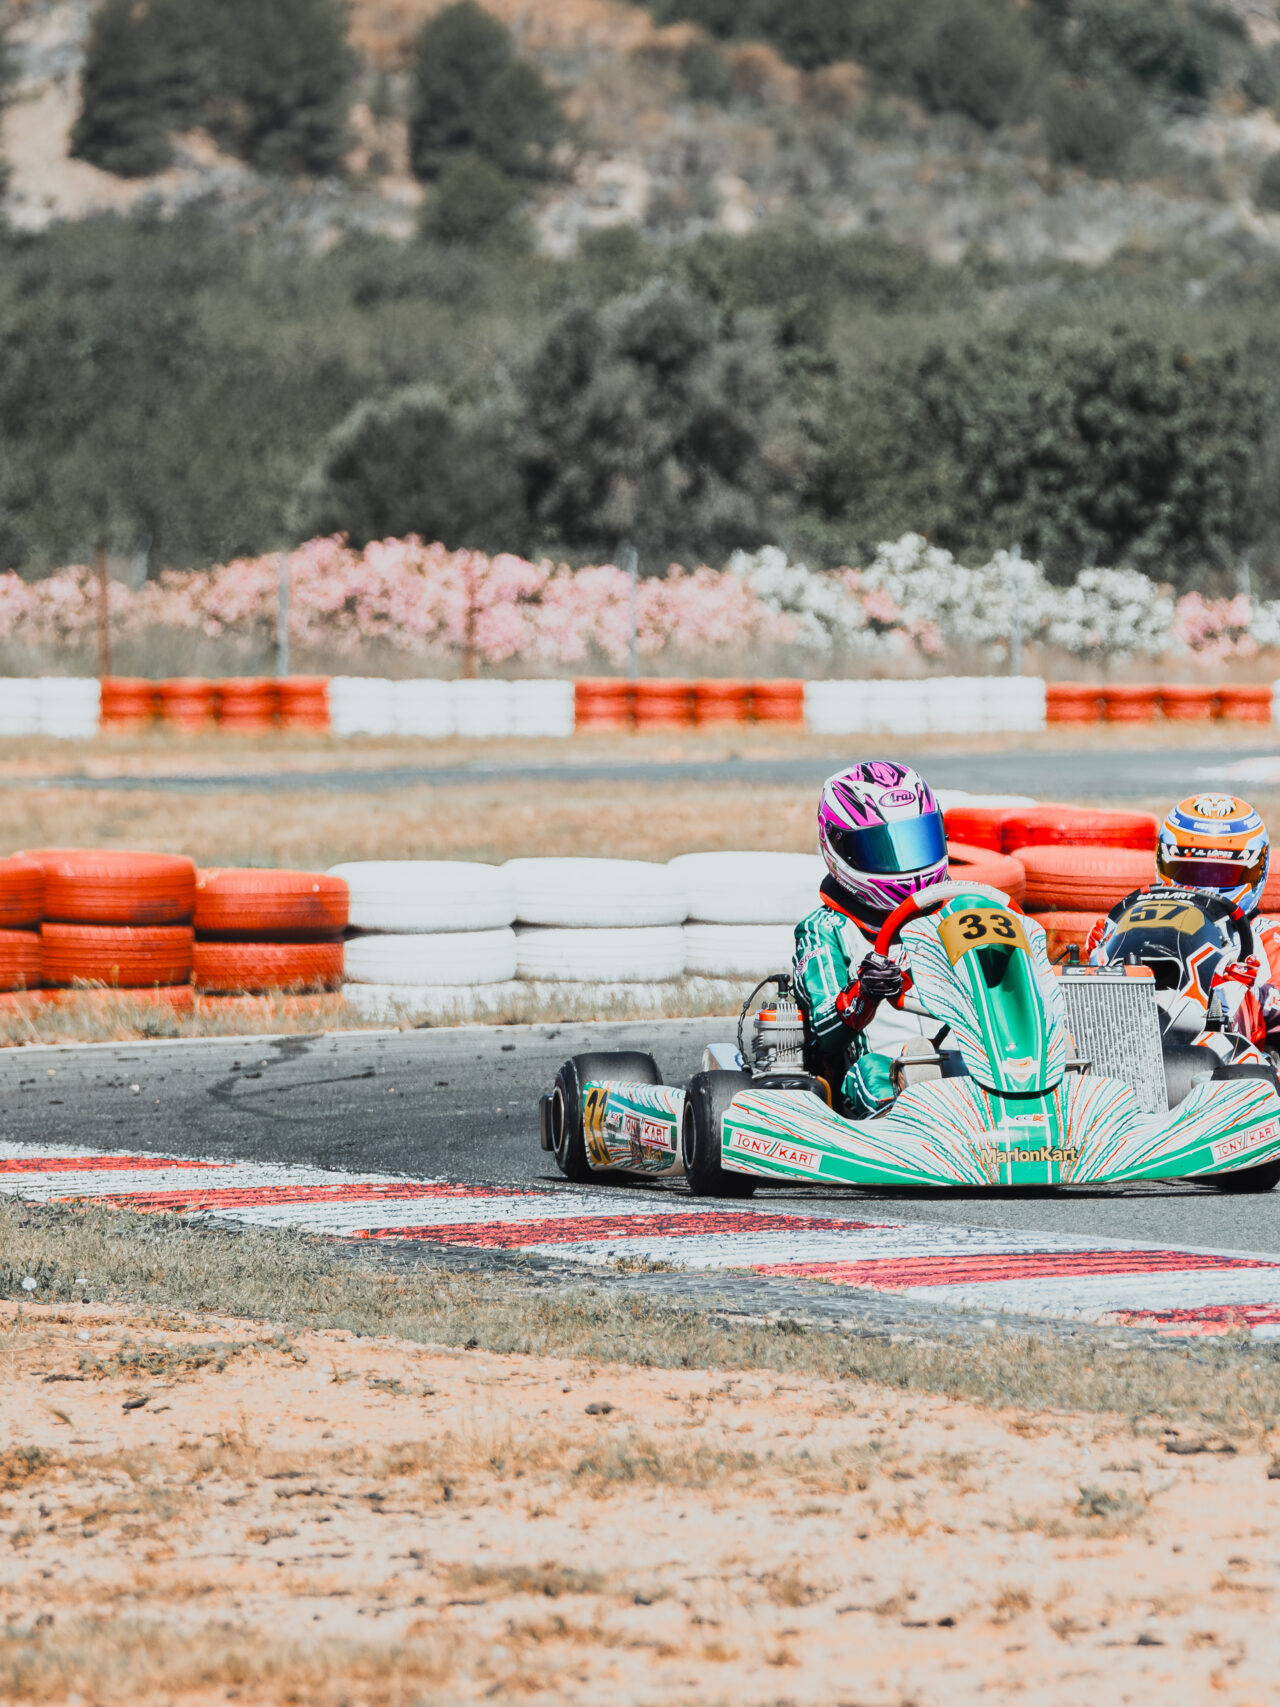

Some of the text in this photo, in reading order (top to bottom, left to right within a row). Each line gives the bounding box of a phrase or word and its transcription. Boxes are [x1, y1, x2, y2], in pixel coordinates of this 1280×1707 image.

[1129, 903, 1190, 922] 57
[958, 913, 1017, 940] 33
[980, 1145, 1079, 1165] MarlonKart
